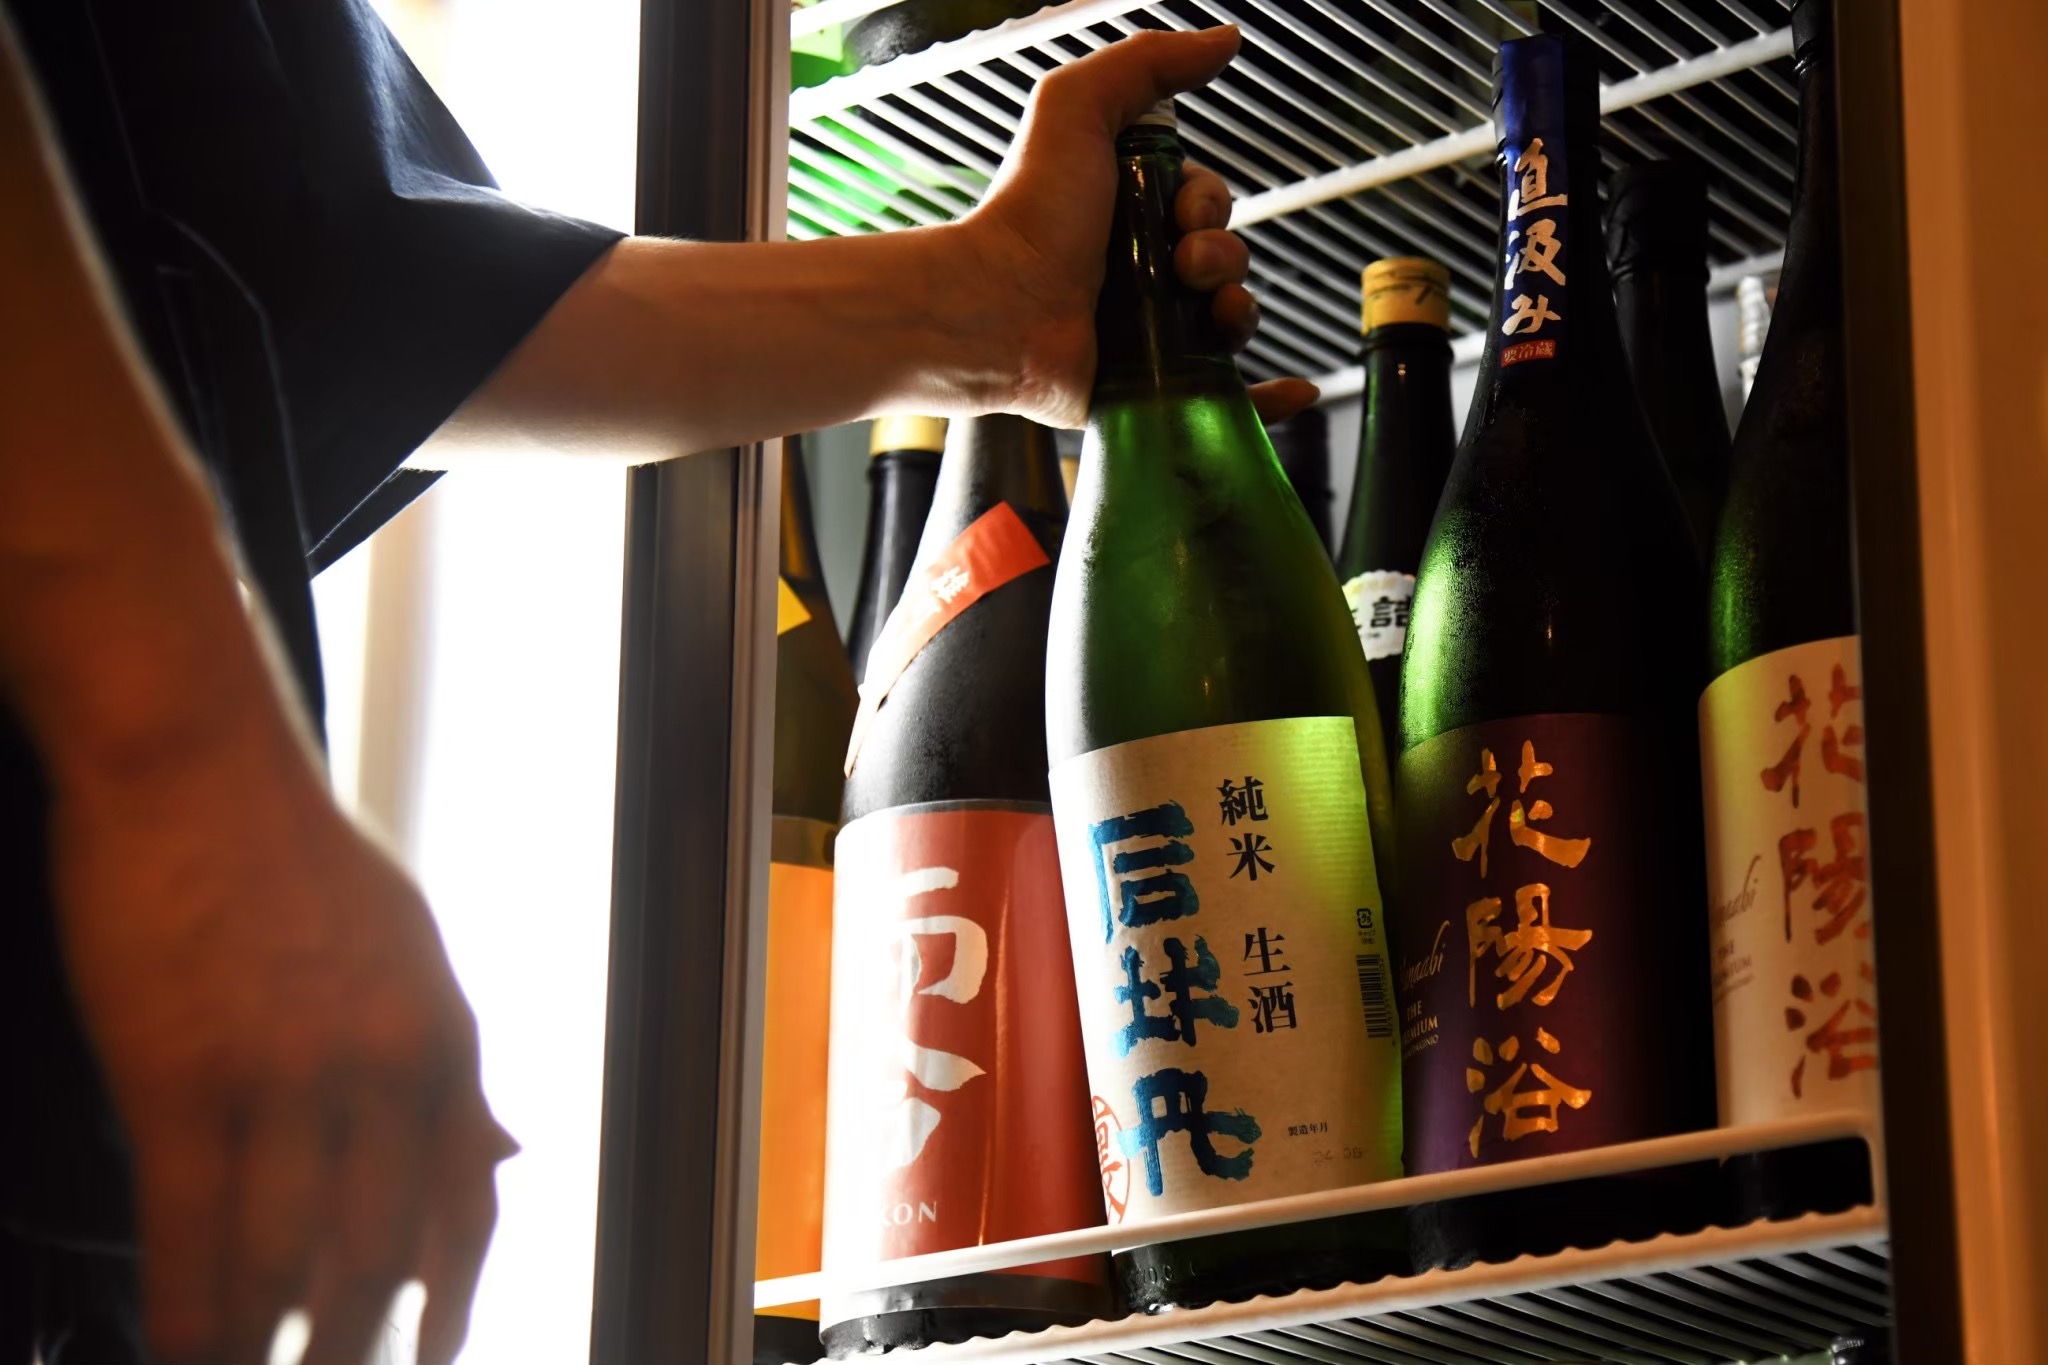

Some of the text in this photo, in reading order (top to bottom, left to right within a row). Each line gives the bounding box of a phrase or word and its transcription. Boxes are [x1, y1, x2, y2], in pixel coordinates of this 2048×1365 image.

[1502, 137, 1568, 337] 直汲み
[1503, 341, 1553, 363] 要冷蔵
[1216, 776, 1297, 1033] 純米 生酒
[1451, 739, 1593, 1158] 花陽浴
[1287, 1121, 1329, 1138] 製造年月
